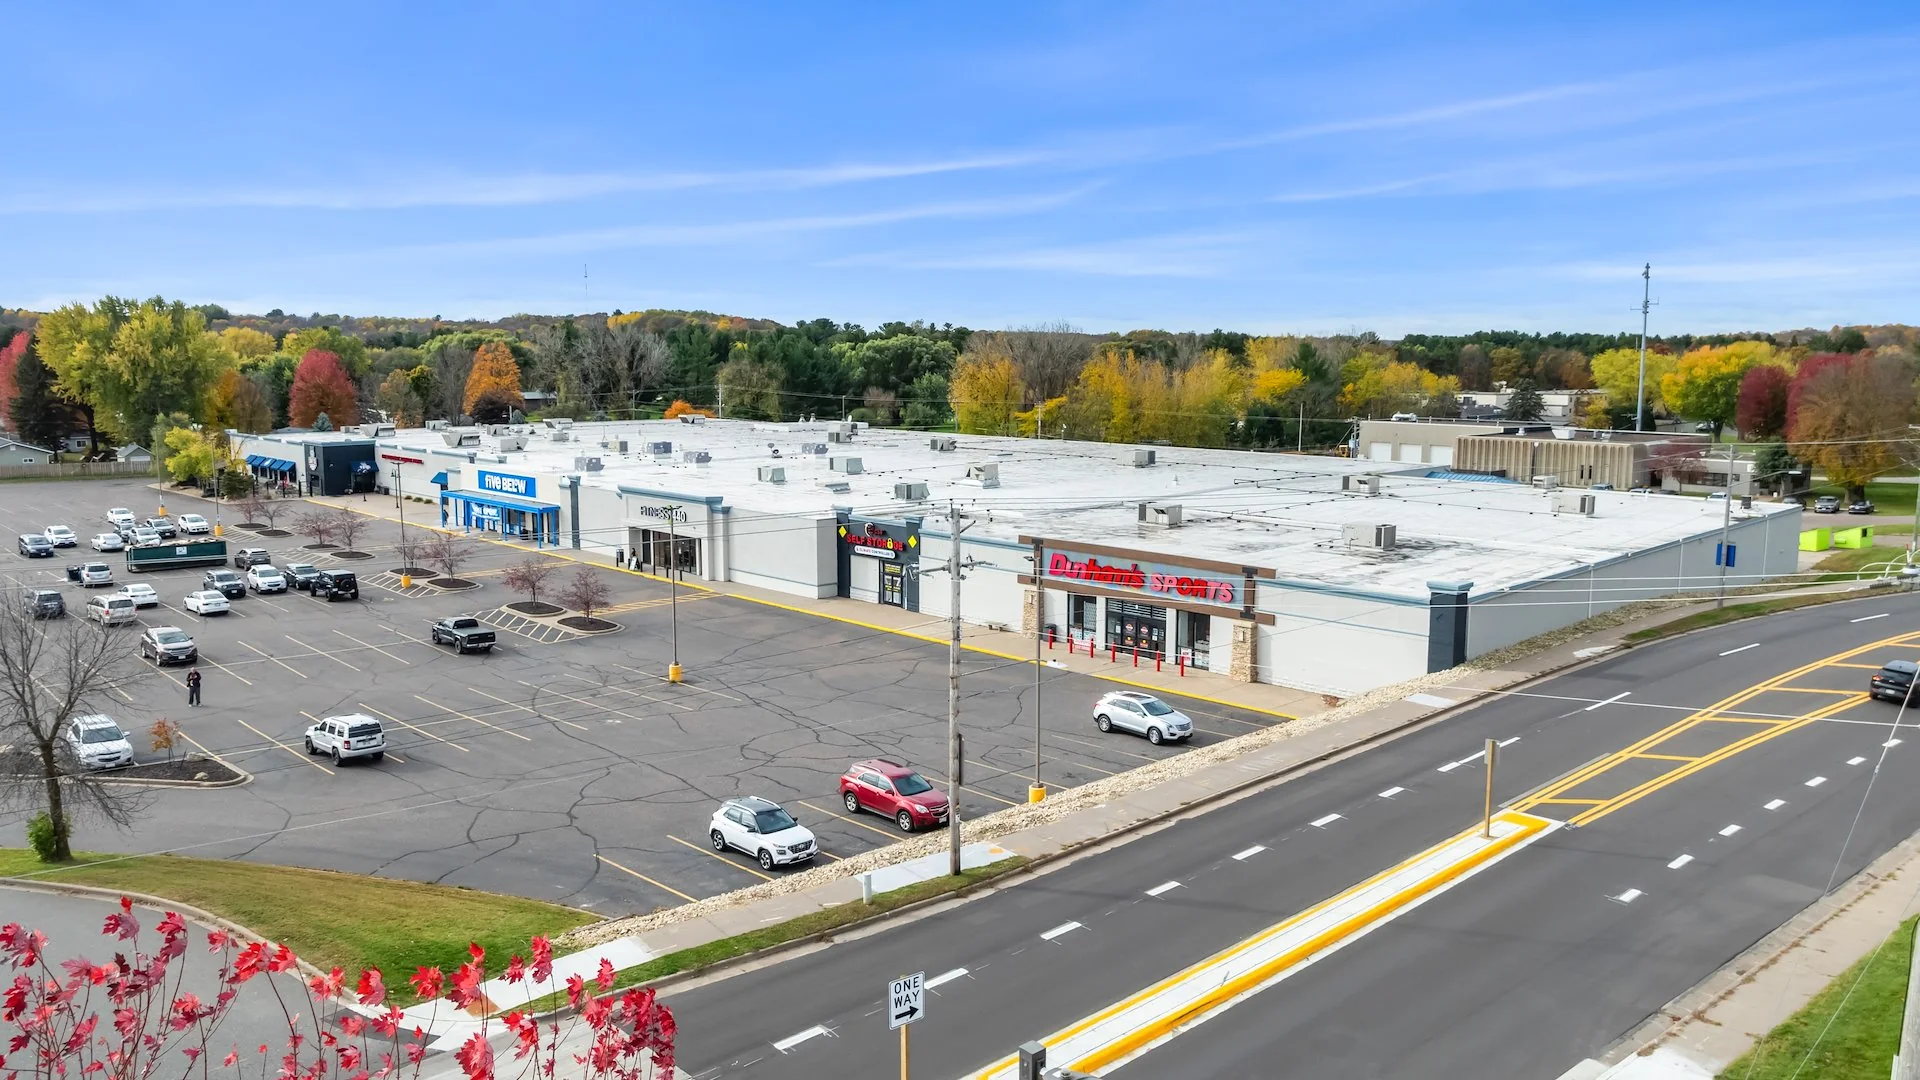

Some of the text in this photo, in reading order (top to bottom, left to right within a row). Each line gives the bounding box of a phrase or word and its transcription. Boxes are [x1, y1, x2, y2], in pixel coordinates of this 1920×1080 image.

[847, 534, 865, 545] SELF
[1049, 553, 1235, 603] Dunham's SPORTS
[894, 976, 919, 994] ONE
[894, 990, 919, 1008] WAY
